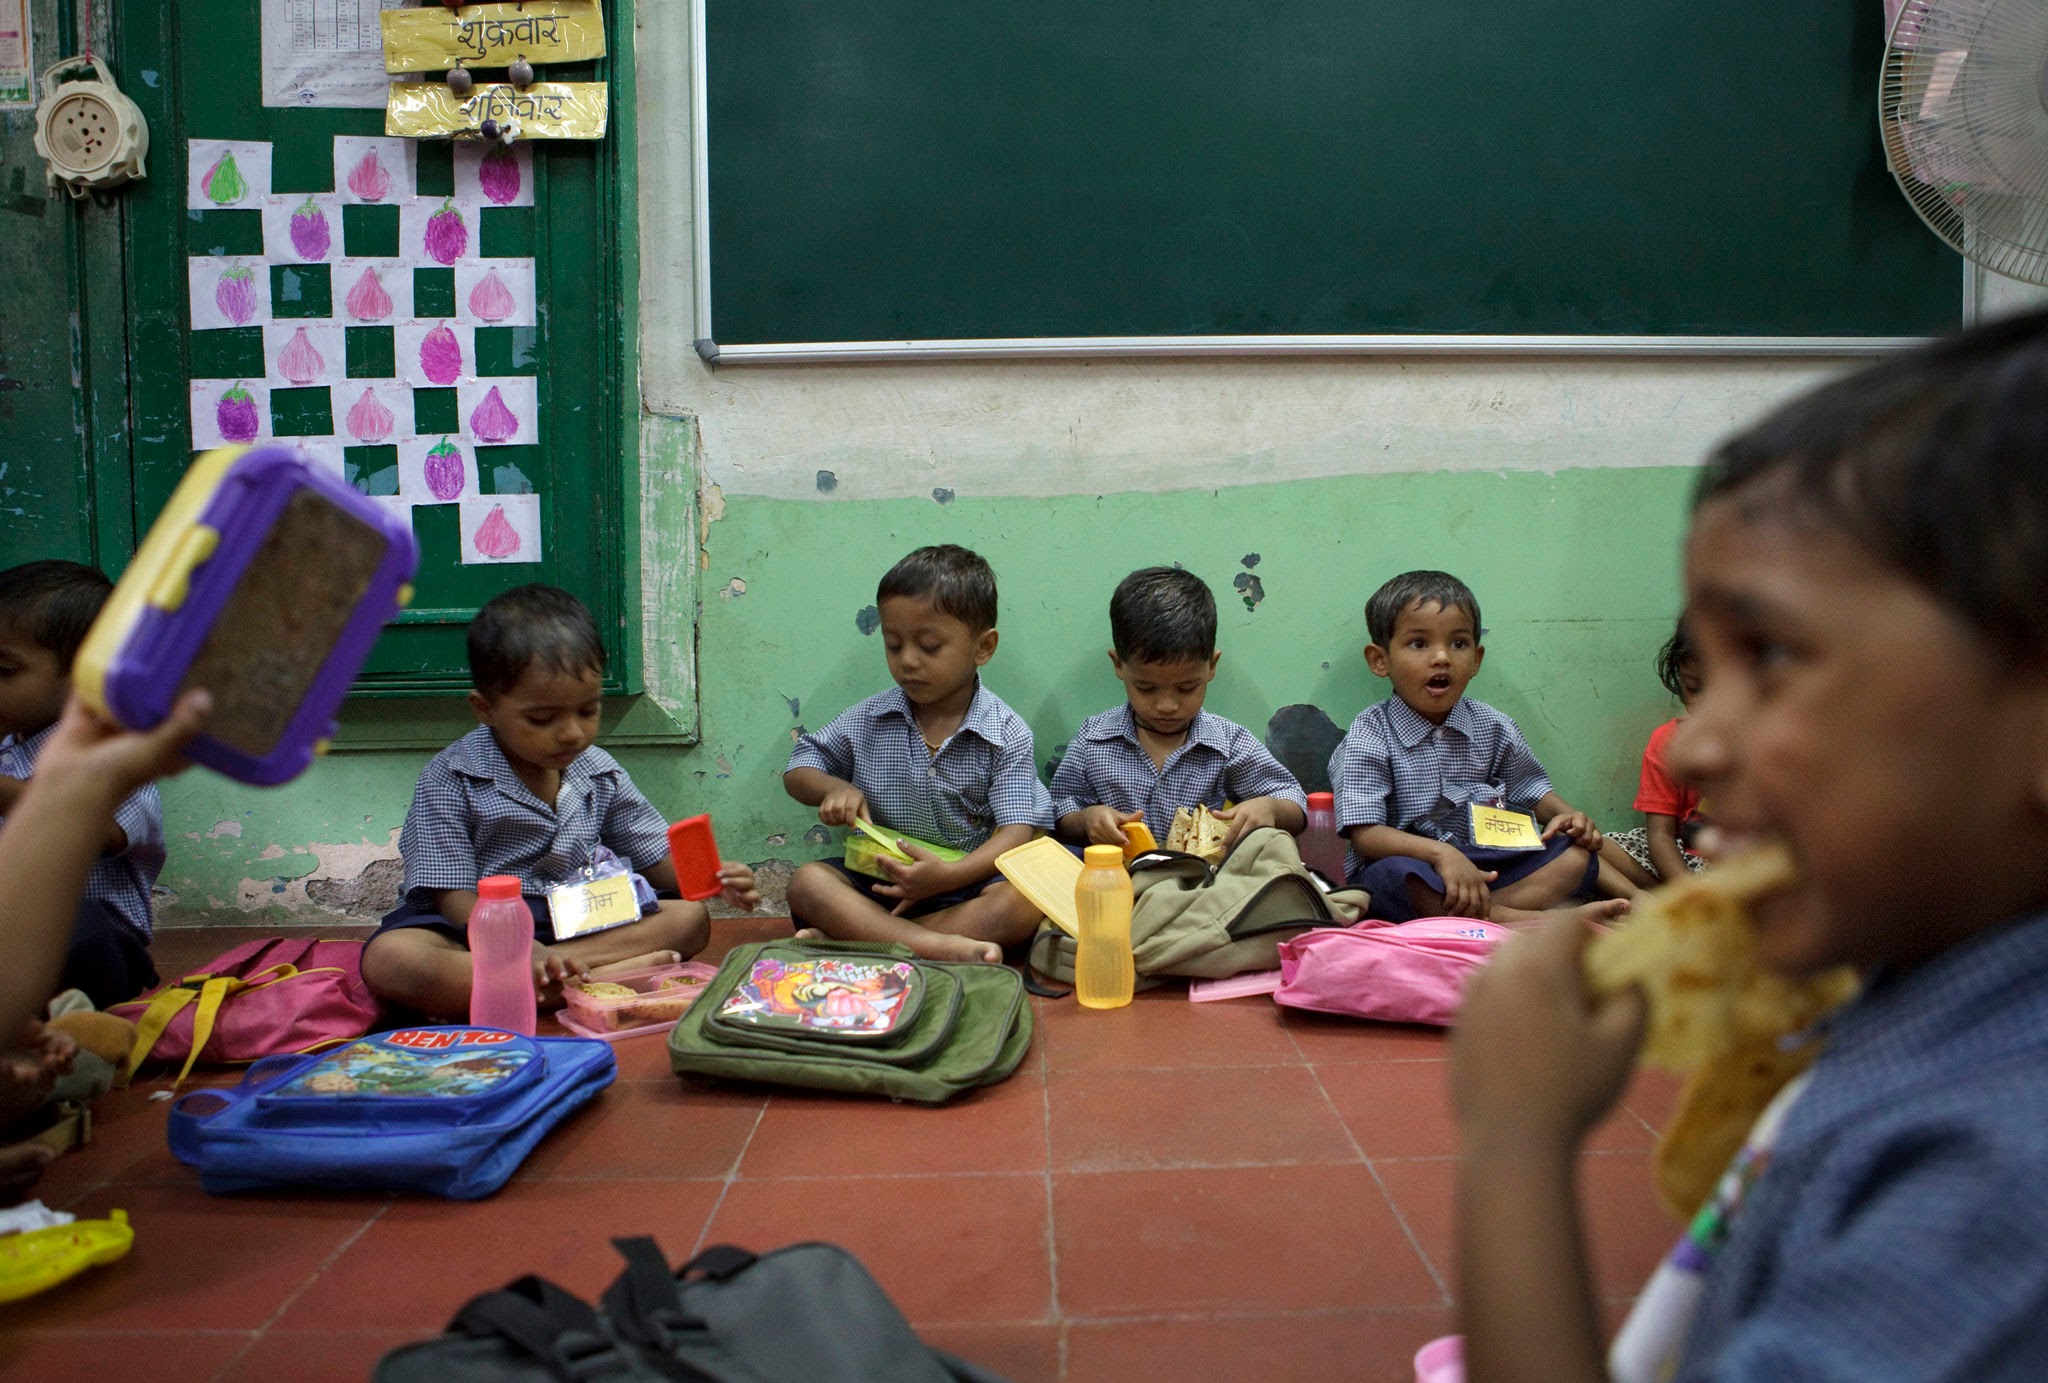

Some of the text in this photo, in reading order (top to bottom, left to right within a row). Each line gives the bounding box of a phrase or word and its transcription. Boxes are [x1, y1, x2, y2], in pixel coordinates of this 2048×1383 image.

[442, 15, 570, 60] शुक्रवार
[455, 85, 572, 121] शनिवार
[385, 1030, 517, 1049] BEN 10
